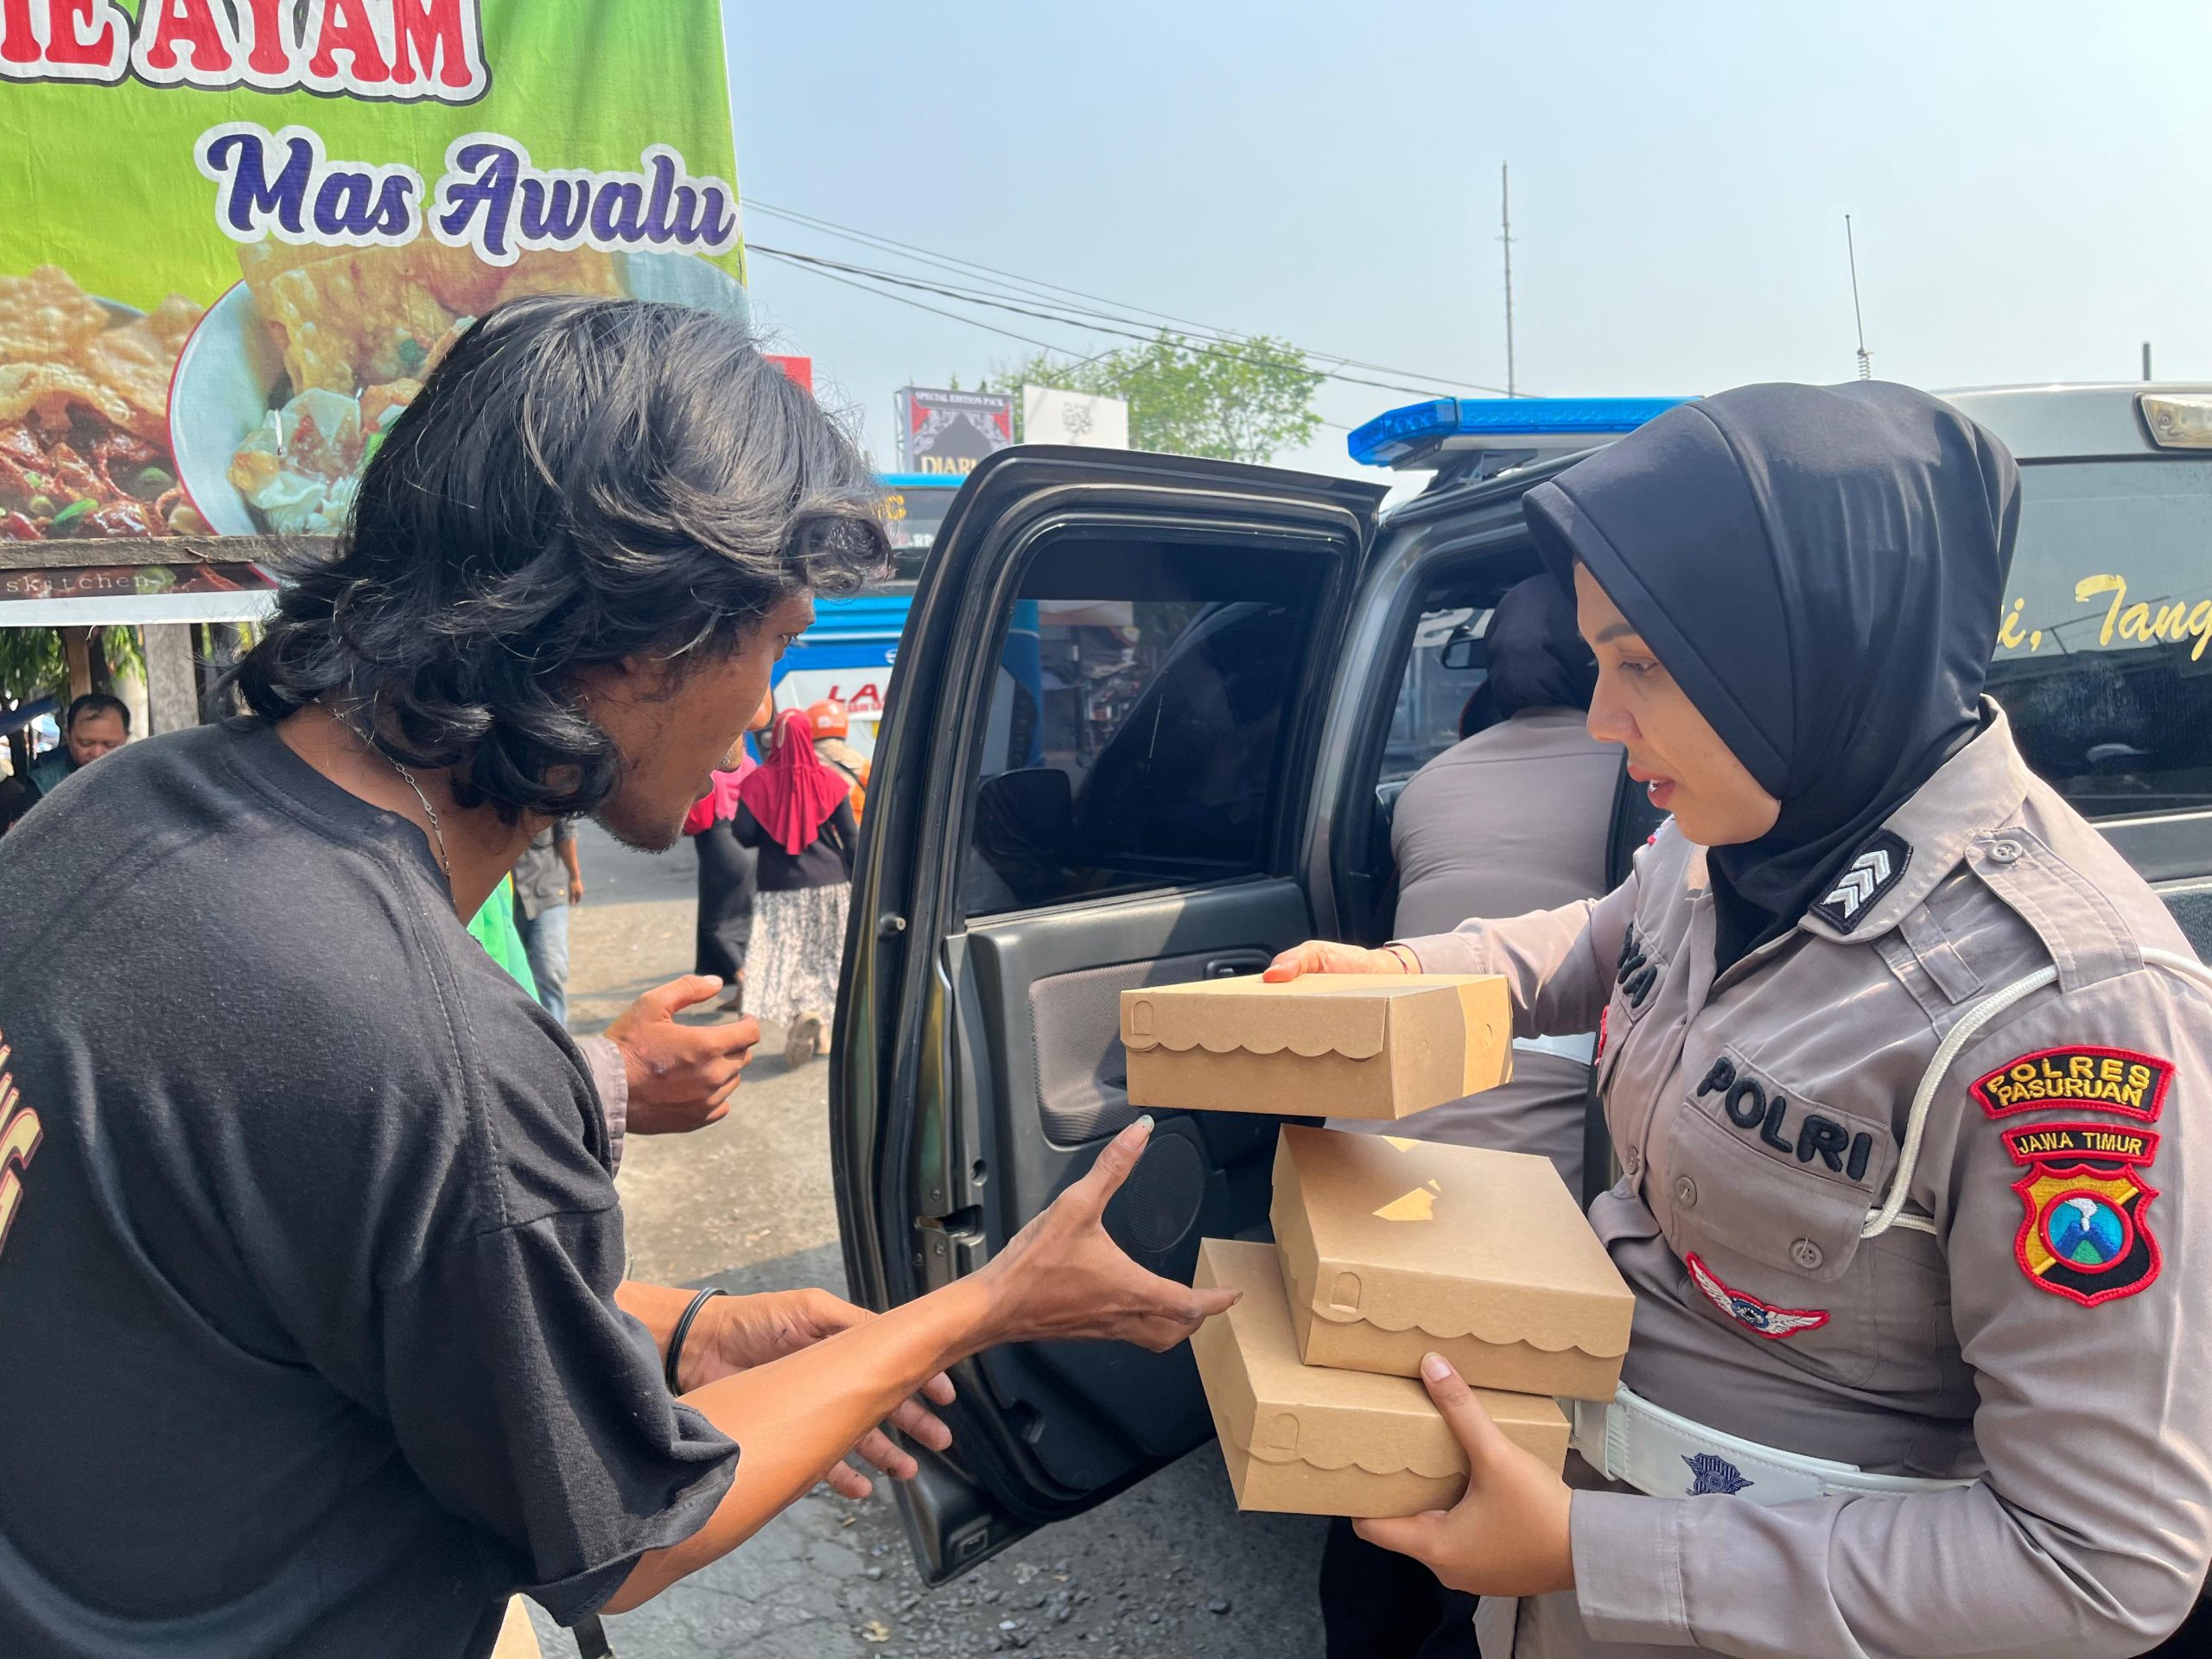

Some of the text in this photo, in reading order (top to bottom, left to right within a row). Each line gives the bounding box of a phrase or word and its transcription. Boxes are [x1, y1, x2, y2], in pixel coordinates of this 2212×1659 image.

[145, 0, 474, 88] AYAM
[207, 134, 736, 256] Mas Awalu
[1986, 1056, 2151, 1094] POLRES
[1997, 1077, 2143, 1107] PASURUAN
[1697, 1056, 1873, 1182] POLRI
[2018, 1132, 2142, 1156] JAWA TIMUR
